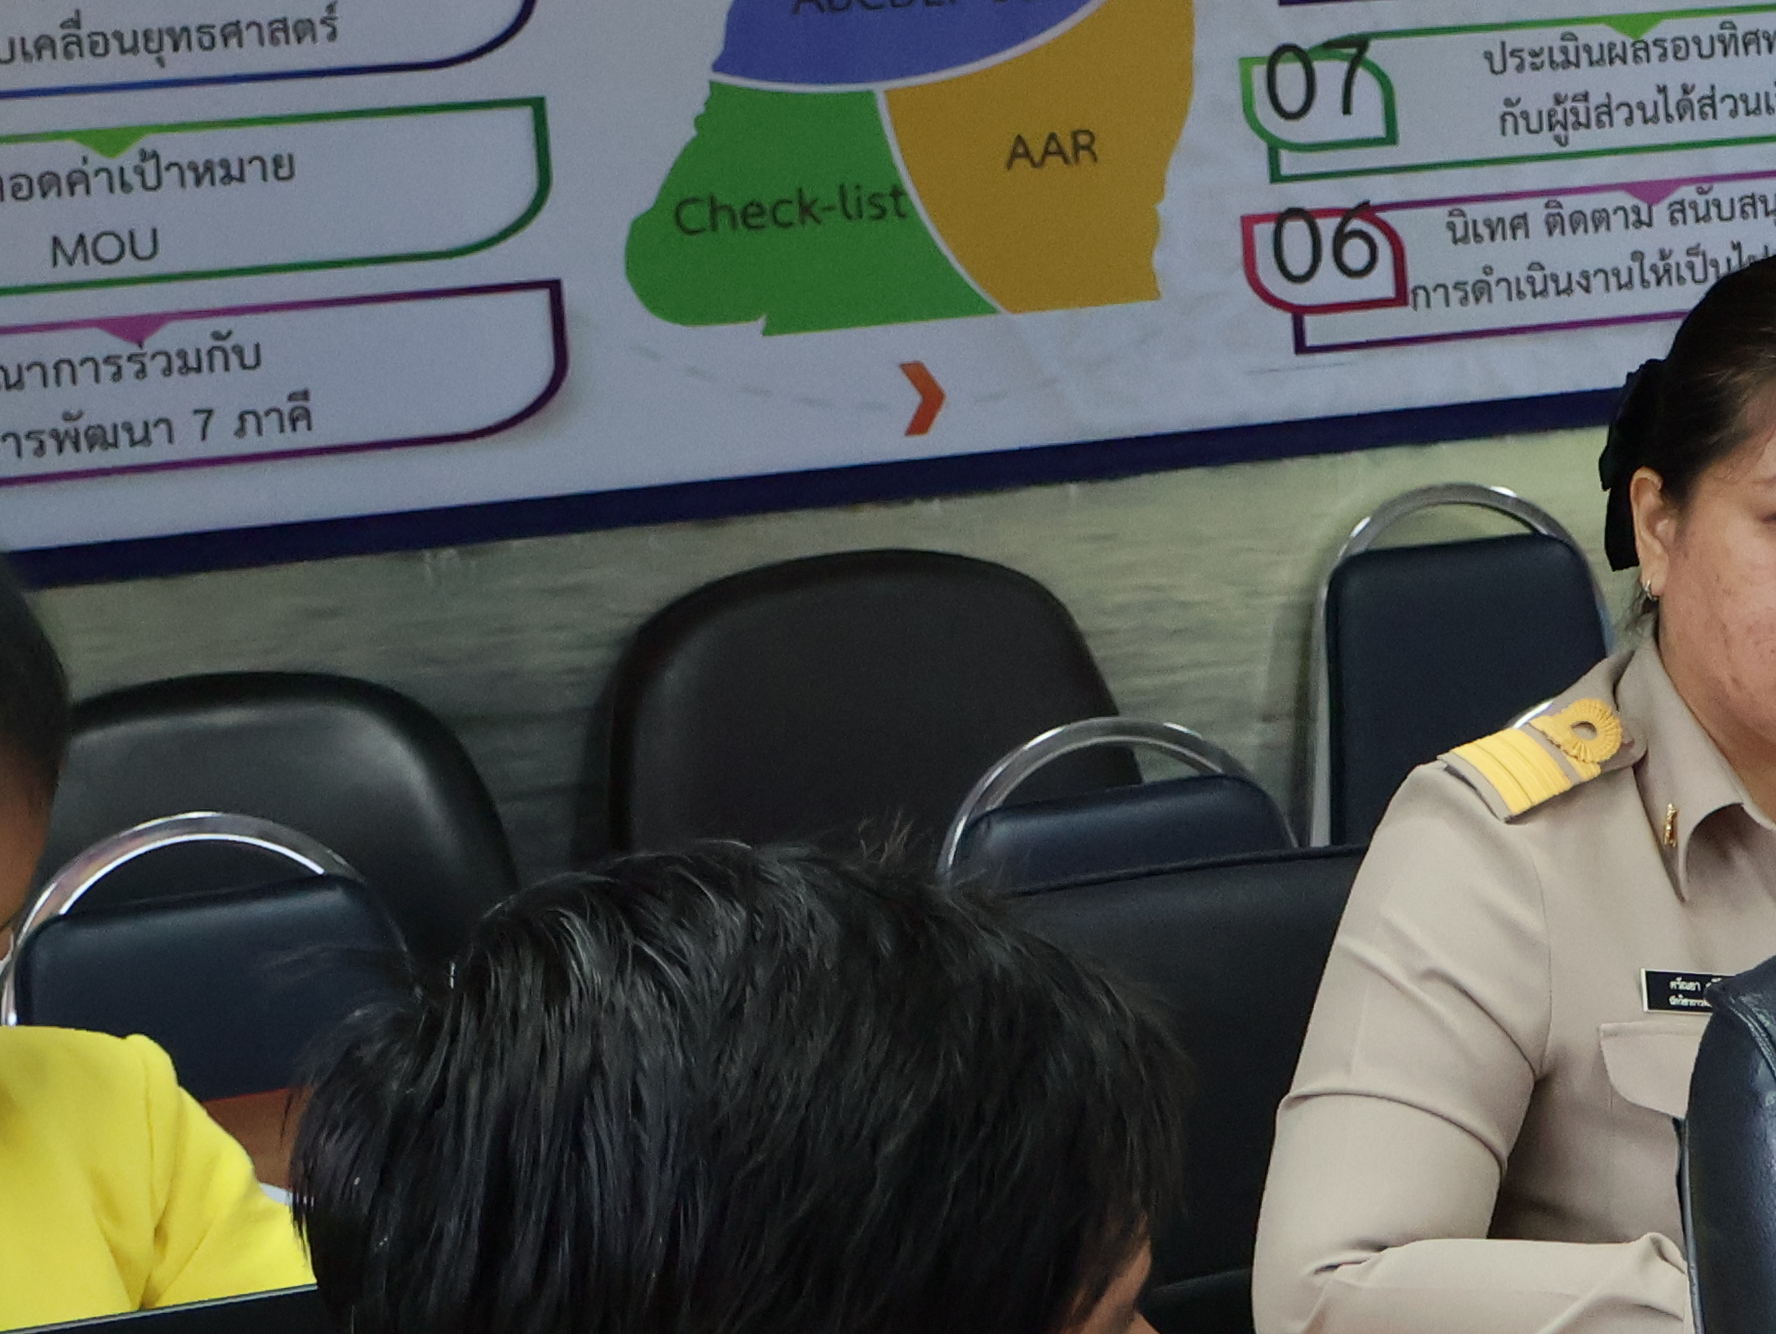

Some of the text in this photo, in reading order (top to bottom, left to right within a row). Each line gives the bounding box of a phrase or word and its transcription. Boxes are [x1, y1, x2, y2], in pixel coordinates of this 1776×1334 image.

[1266, 39, 1372, 121] 07
[0, 147, 296, 203] อดค่าเป้าหมาย
[1005, 129, 1098, 170] AAR
[673, 183, 909, 236] Check-list
[1446, 209, 1529, 247] นิเทศ
[1544, 199, 1654, 238] ติดตาม
[51, 227, 160, 268] MOU
[1272, 201, 1380, 284] 06
[193, 408, 214, 442] 7
[233, 388, 313, 439] ภาคี
